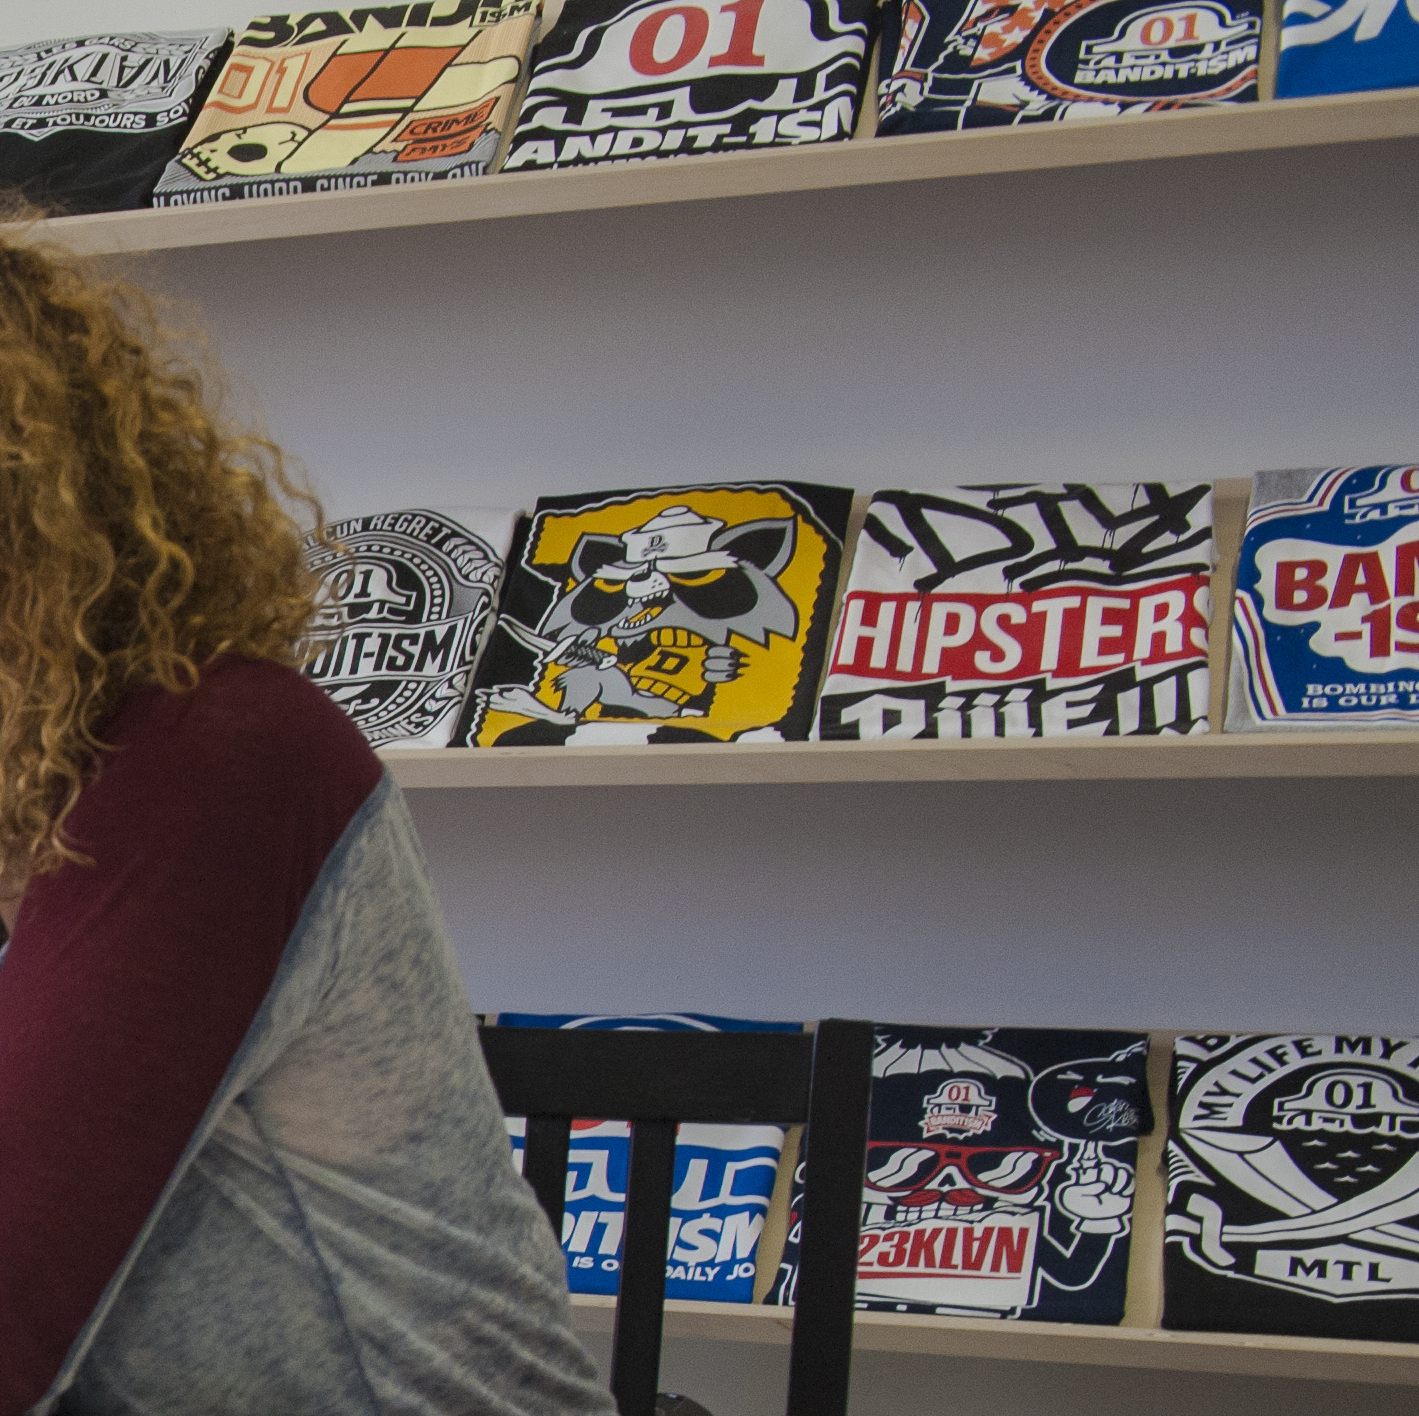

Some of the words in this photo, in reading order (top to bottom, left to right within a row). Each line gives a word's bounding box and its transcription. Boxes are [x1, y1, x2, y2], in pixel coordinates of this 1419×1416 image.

[84, 37, 135, 49] GARS
[629, 0, 765, 76] 01
[1140, 12, 1200, 47] 01
[16, 95, 38, 107] DU
[42, 90, 100, 105] NORD
[11, 115, 36, 129] ET
[47, 113, 145, 128] TOUJOURS
[409, 102, 490, 135] CRIME
[369, 513, 451, 545] REGRET
[331, 569, 374, 600] 01
[837, 585, 1210, 675] HIPSTERS
[1301, 697, 1328, 709] IS
[1338, 693, 1399, 707] OUR
[948, 1085, 971, 1102] 01
[1192, 1081, 1243, 1122] MY
[1228, 1037, 1322, 1084] LIFE
[1334, 1035, 1410, 1060] MY
[1325, 1079, 1376, 1110] 01
[572, 1256, 594, 1268] IS
[859, 1225, 1030, 1274] 23KLAN
[1288, 1256, 1393, 1284] MTL
